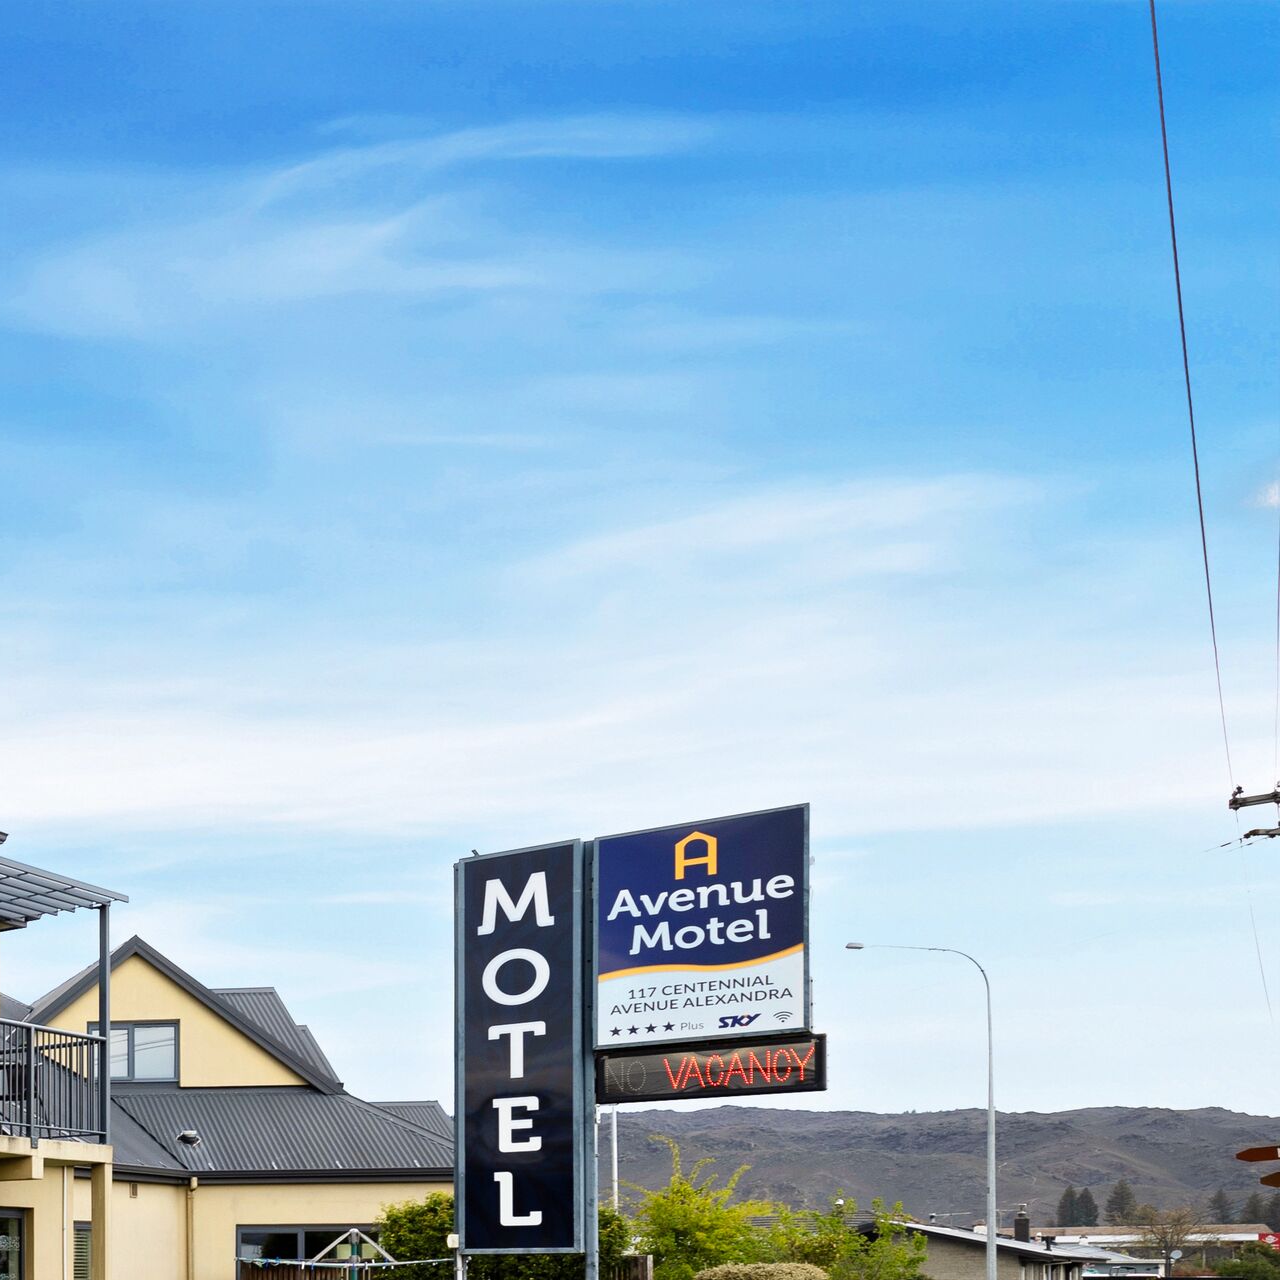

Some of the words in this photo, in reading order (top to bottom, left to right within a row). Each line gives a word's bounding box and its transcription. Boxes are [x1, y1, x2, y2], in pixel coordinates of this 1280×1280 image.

[675, 831, 718, 880] A
[607, 874, 795, 921] Avenue
[629, 909, 771, 955] Motel
[610, 999, 678, 1016] AVENUE
[682, 987, 793, 1009] ALEXANDRA
[628, 986, 657, 999] 117
[661, 975, 774, 996] CENTENNIAL
[680, 1021, 704, 1031] Plus
[718, 1013, 761, 1029] SKY
[477, 871, 555, 1227] MOTEL
[604, 1060, 647, 1094] NO
[663, 1046, 816, 1090] VACANCY
